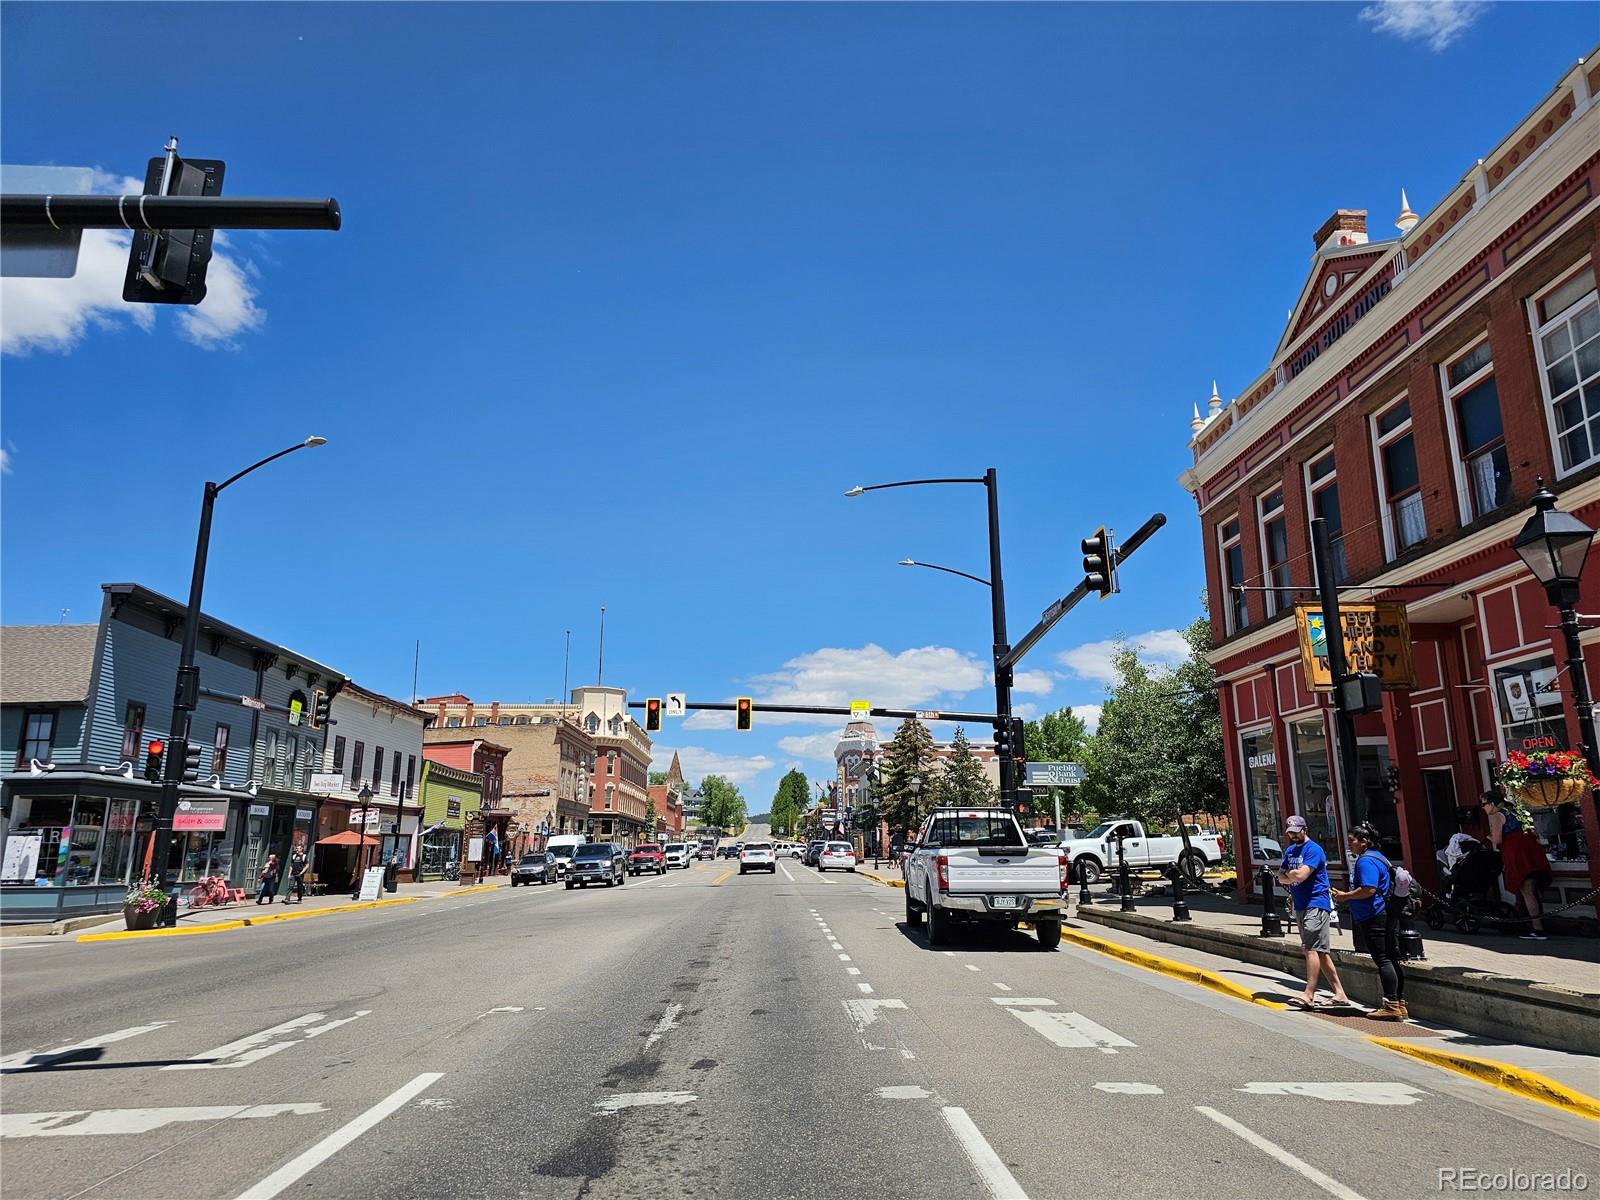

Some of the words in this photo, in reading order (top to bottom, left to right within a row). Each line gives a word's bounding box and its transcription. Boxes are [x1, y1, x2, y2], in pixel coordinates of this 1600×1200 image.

[1350, 640, 1385, 656] AND
[1319, 652, 1398, 672] NVELTY
[1522, 737, 1554, 750] OPEN
[1248, 753, 1277, 769] GALENA
[1048, 770, 1061, 784] &
